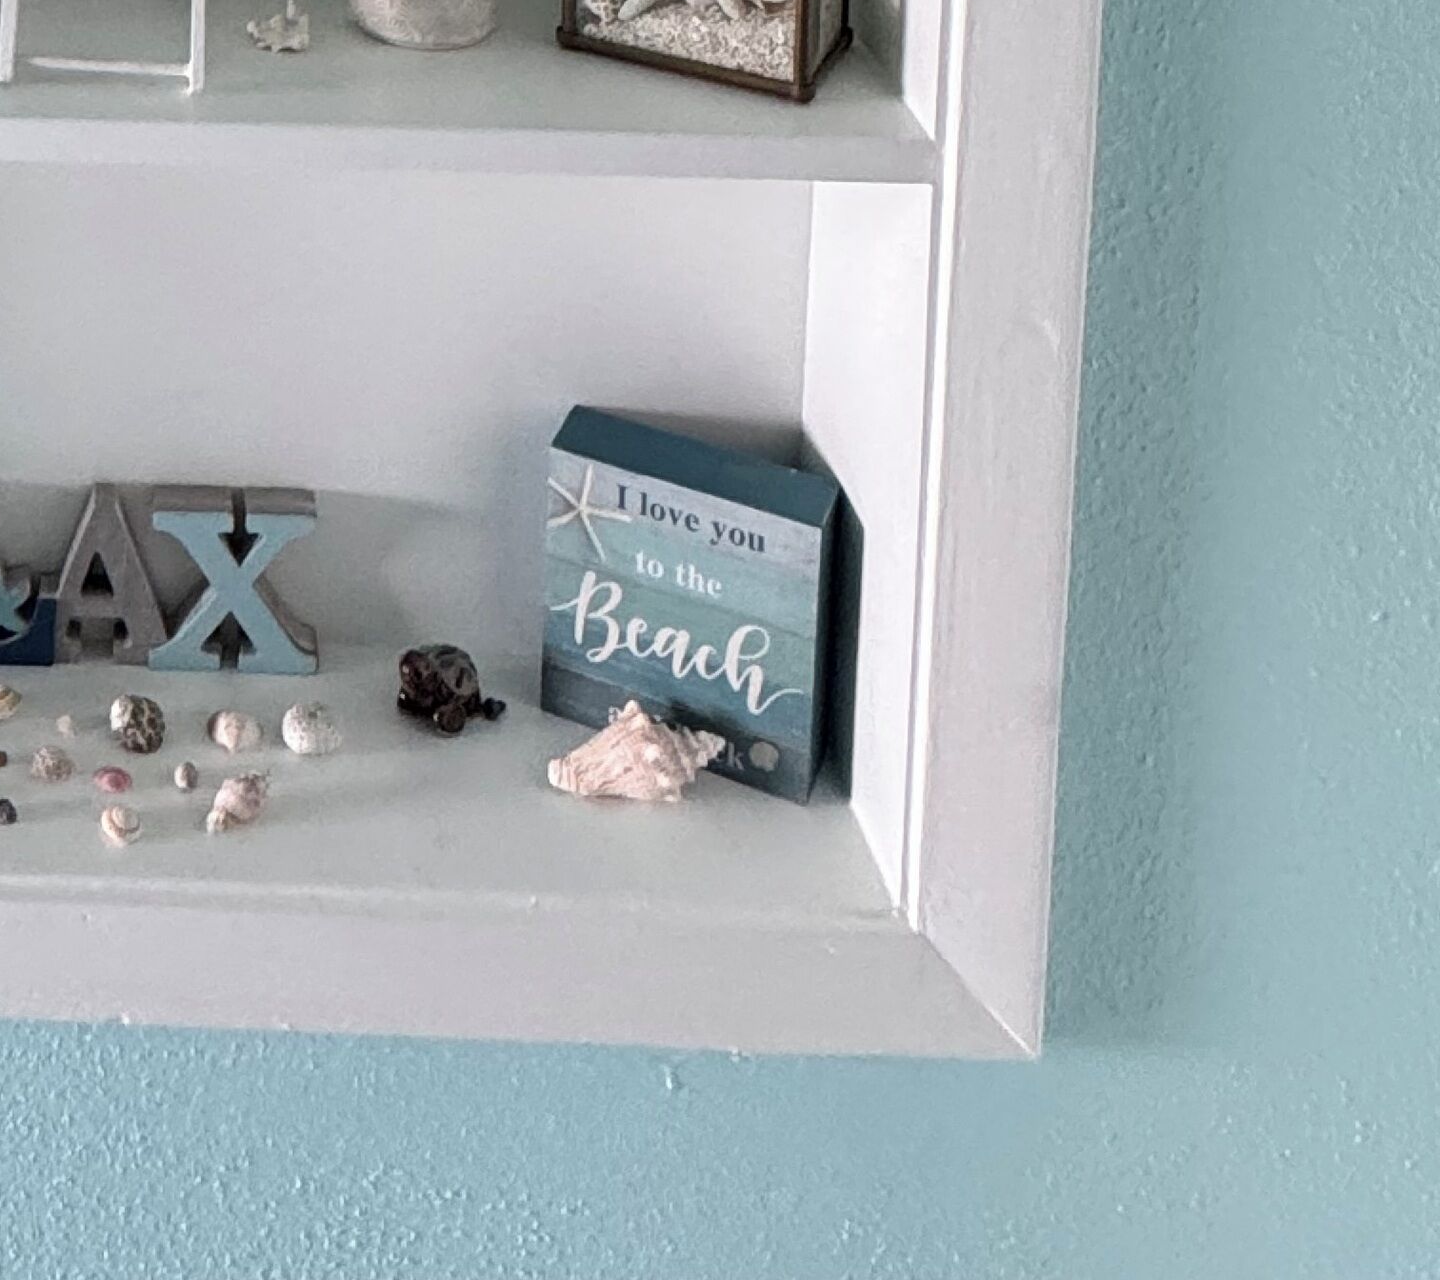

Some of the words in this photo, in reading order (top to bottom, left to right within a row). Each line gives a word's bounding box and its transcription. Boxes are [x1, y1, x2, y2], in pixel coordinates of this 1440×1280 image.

[616, 484, 628, 511] I
[639, 491, 701, 533] love
[710, 518, 767, 552] you
[635, 549, 666, 579] to
[675, 560, 724, 598] the
[549, 570, 806, 716] Beach
